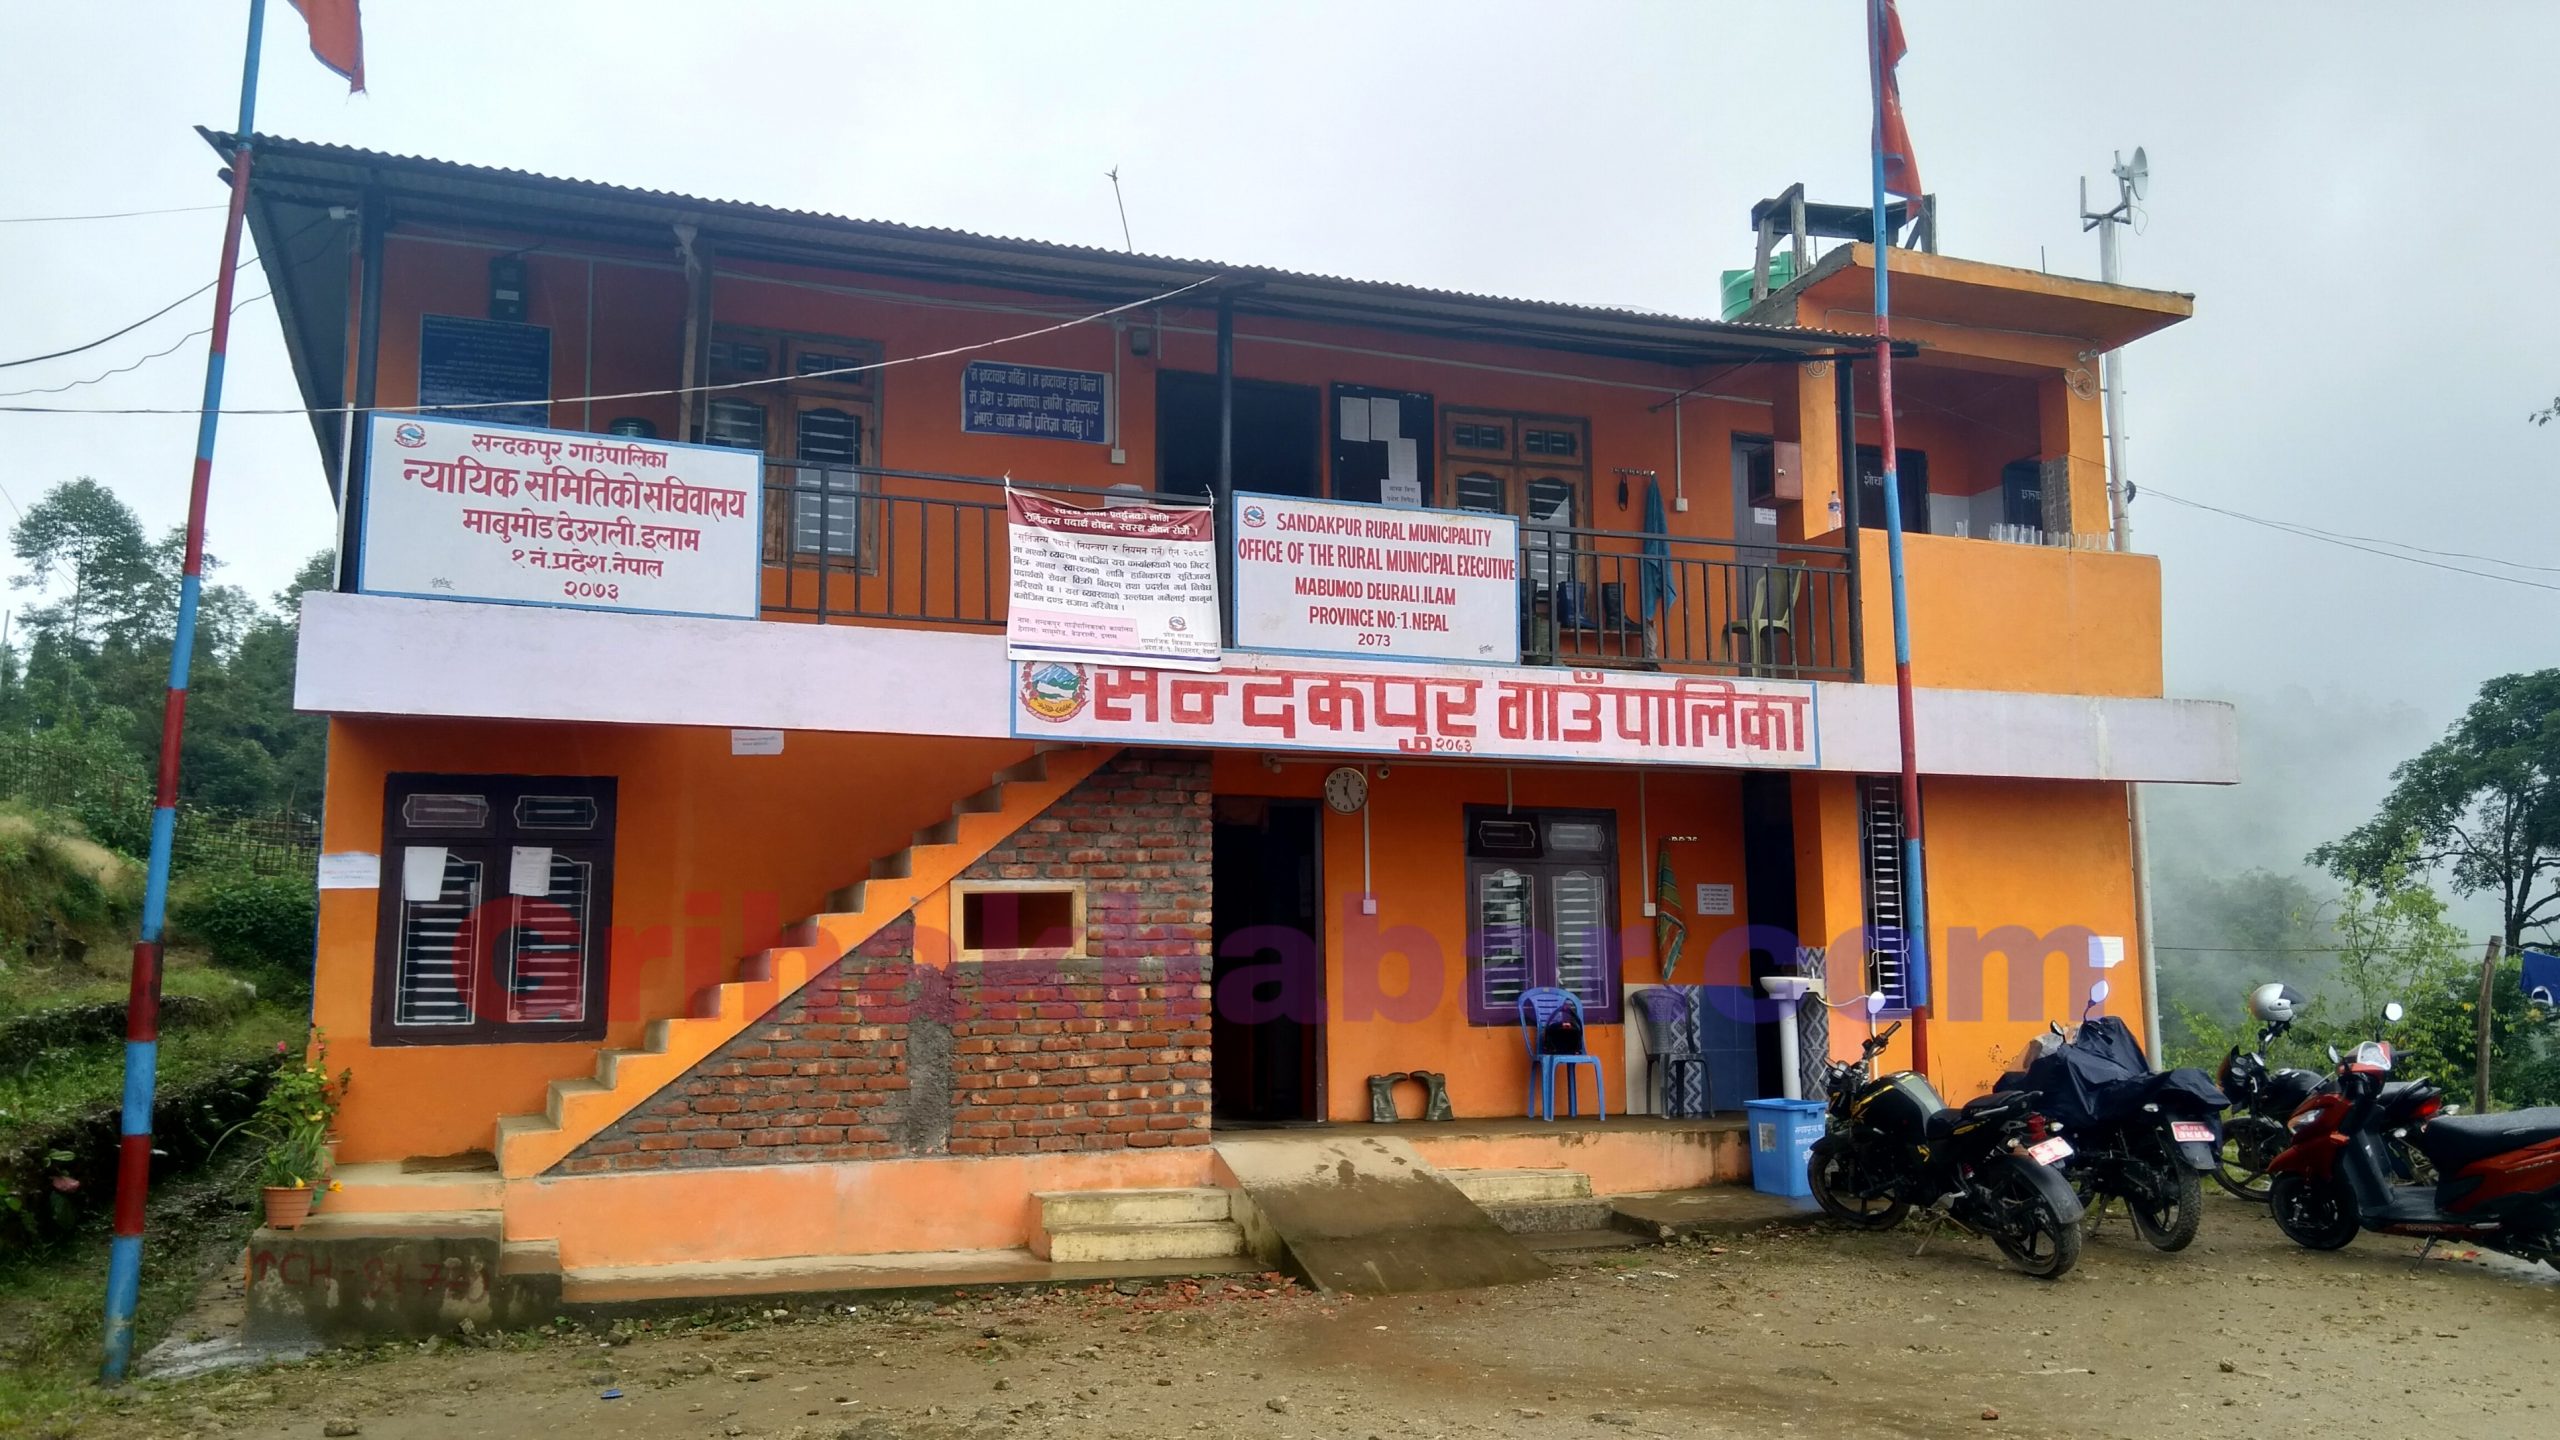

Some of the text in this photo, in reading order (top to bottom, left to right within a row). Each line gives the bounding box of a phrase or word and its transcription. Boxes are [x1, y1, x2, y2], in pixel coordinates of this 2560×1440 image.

[472, 433, 668, 469] सन्दकपुर गाउँपालिका
[403, 455, 747, 523] न्यायिक समितिको सचिवालय
[462, 508, 554, 543] माबुमोड
[1064, 517, 1089, 529] पदार्थ
[1119, 522, 1145, 533] स्वस्थ
[1277, 512, 1491, 547] SANDAKPUR RURAL MUNICIPALITY
[1122, 543, 1147, 555] नियमन
[1238, 538, 1516, 580] OFFICE OF THE RURAL MUNICIPAL EXECUTIVE
[564, 581, 619, 602] २०७३
[1295, 577, 1363, 599] MABUMOD
[1309, 606, 1374, 628] PROVINCE
[1358, 632, 1391, 647] 2073
[1095, 664, 1810, 752] सन्दकपुर गाउँपालिका
